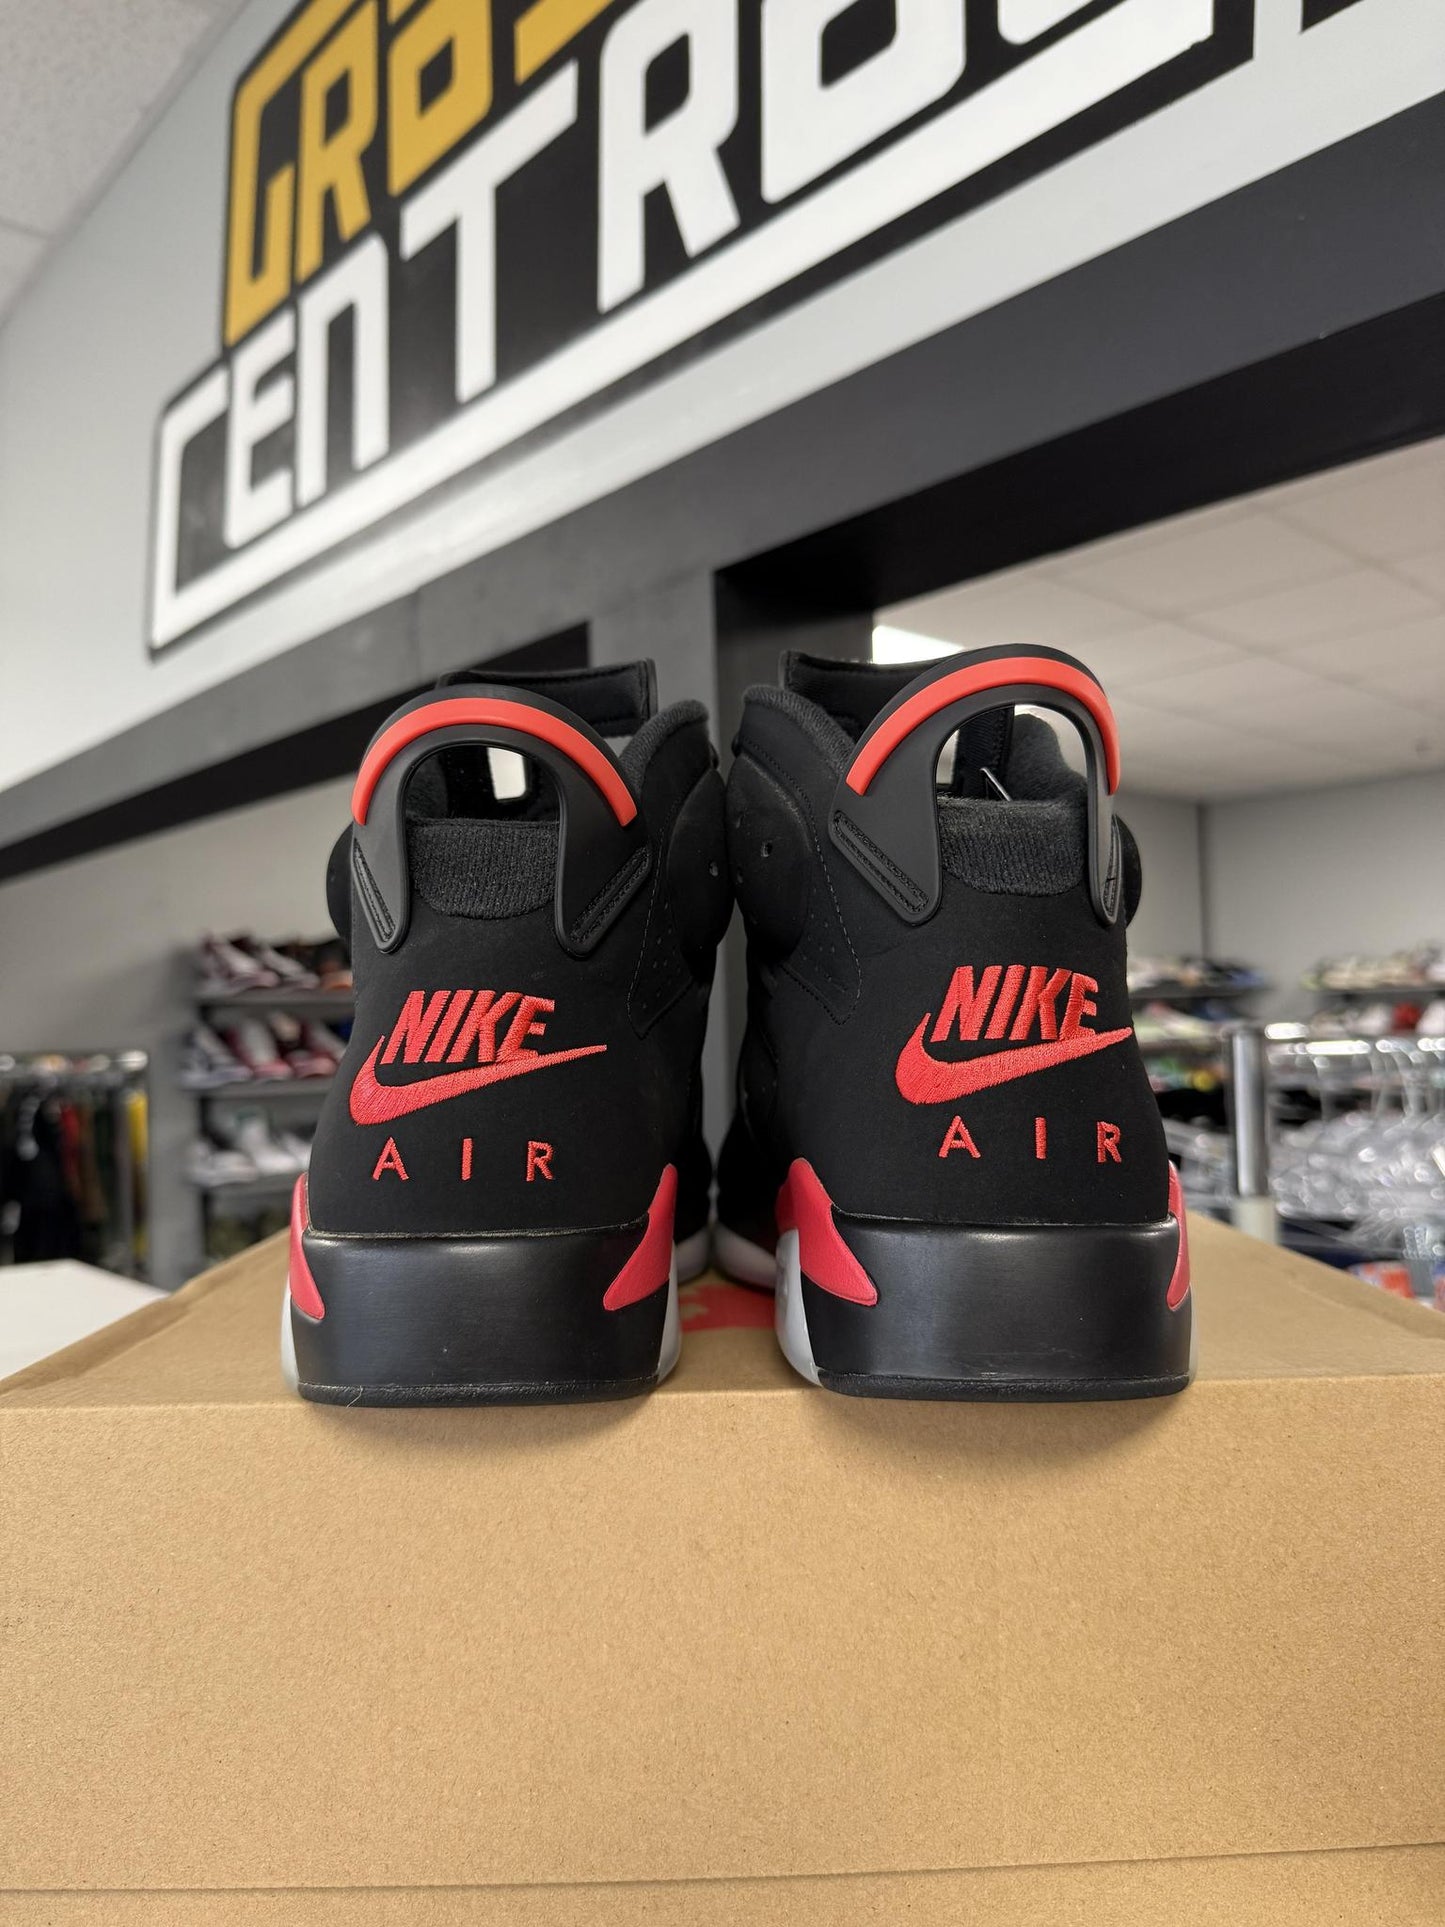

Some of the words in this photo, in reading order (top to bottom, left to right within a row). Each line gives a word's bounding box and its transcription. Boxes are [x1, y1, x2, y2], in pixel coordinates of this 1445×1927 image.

[379, 989, 556, 1065] NIKE
[930, 964, 1099, 1042] NIKE
[371, 1136, 554, 1182] AIR
[938, 1115, 1122, 1163] AIR
